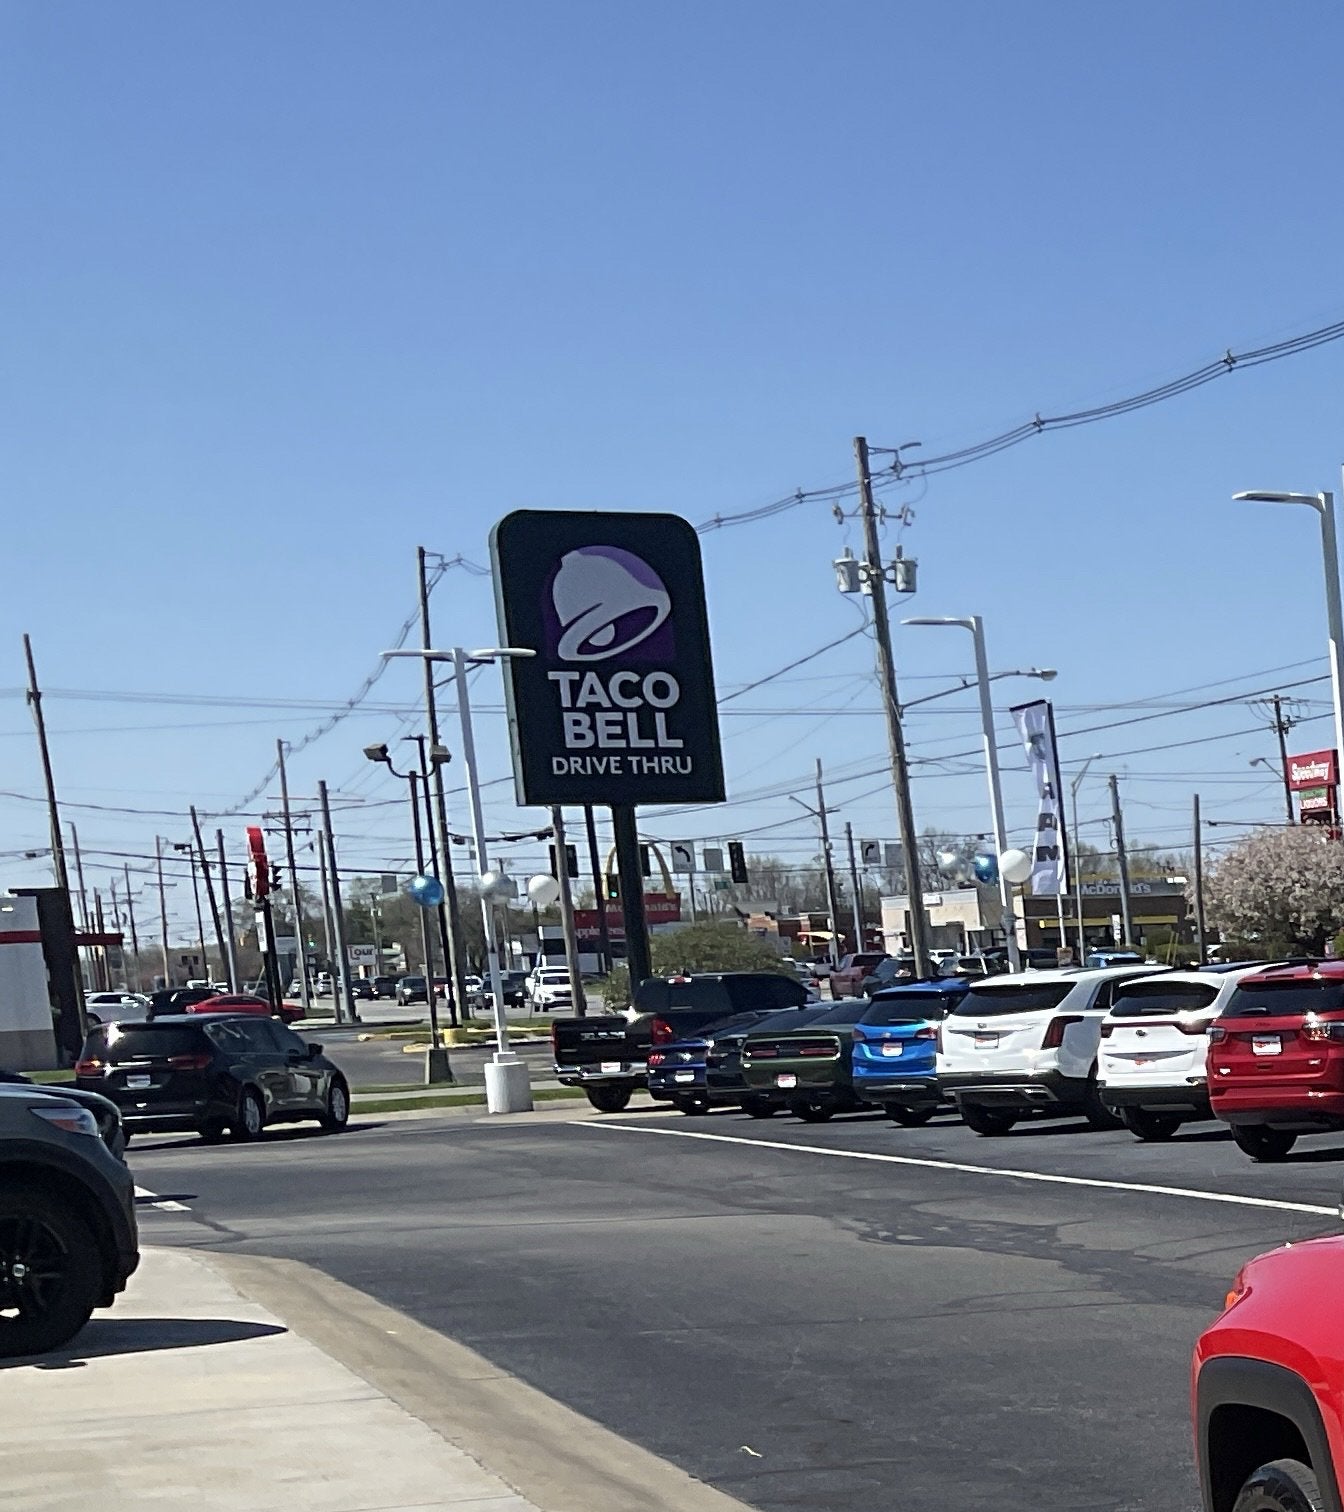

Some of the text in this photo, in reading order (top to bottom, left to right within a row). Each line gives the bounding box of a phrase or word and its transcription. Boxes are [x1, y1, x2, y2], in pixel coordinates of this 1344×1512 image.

[547, 671, 680, 709] TACO
[562, 711, 684, 749] BELL
[552, 755, 693, 775] DRIVE THRU
